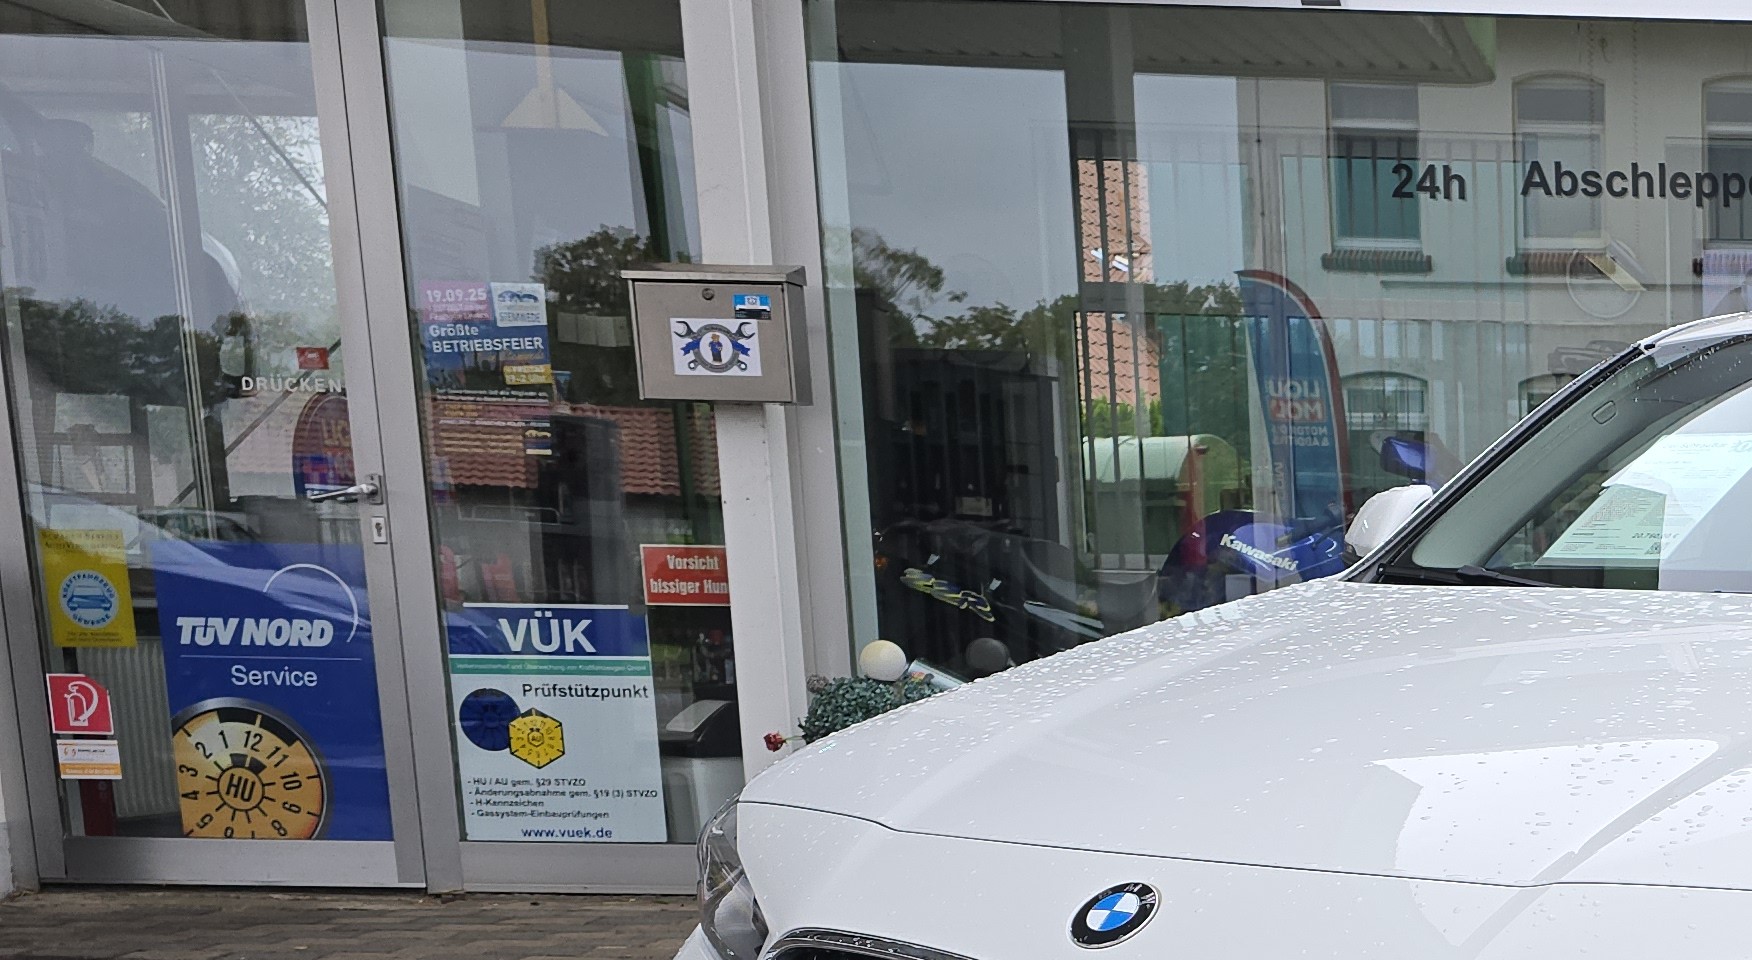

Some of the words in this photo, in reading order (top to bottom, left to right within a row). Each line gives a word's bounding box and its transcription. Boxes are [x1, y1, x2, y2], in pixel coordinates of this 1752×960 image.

[1391, 162, 1467, 201] 24h
[426, 288, 487, 302] 19.09.25
[429, 324, 479, 337] Größte
[432, 336, 545, 353] BETRIEBSFEIER
[241, 374, 343, 393] DRÜCKEN
[1220, 533, 1299, 571] Kawasaki
[666, 554, 720, 570] Vorsicht
[649, 578, 701, 596] bissiger
[240, 617, 334, 647] NORD
[498, 610, 597, 654] VÜK
[231, 664, 318, 687] Service
[522, 683, 649, 701] Prüfstützpunkt
[244, 730, 264, 752] 12
[195, 742, 213, 759] 2
[266, 746, 289, 768] 11
[179, 764, 198, 777] 3
[225, 773, 256, 803] HU
[280, 771, 302, 791] 10
[473, 778, 487, 786] HU
[494, 778, 508, 786] AU
[554, 778, 586, 787] STVZO
[474, 786, 566, 798] Änderungsabnahme
[626, 789, 658, 798] STVZO
[475, 798, 545, 807] H-Kennzeichen
[477, 809, 610, 820] Gassystem-Einbauprüfungen
[271, 819, 287, 837] 8
[521, 826, 613, 840] www.vuek.de
